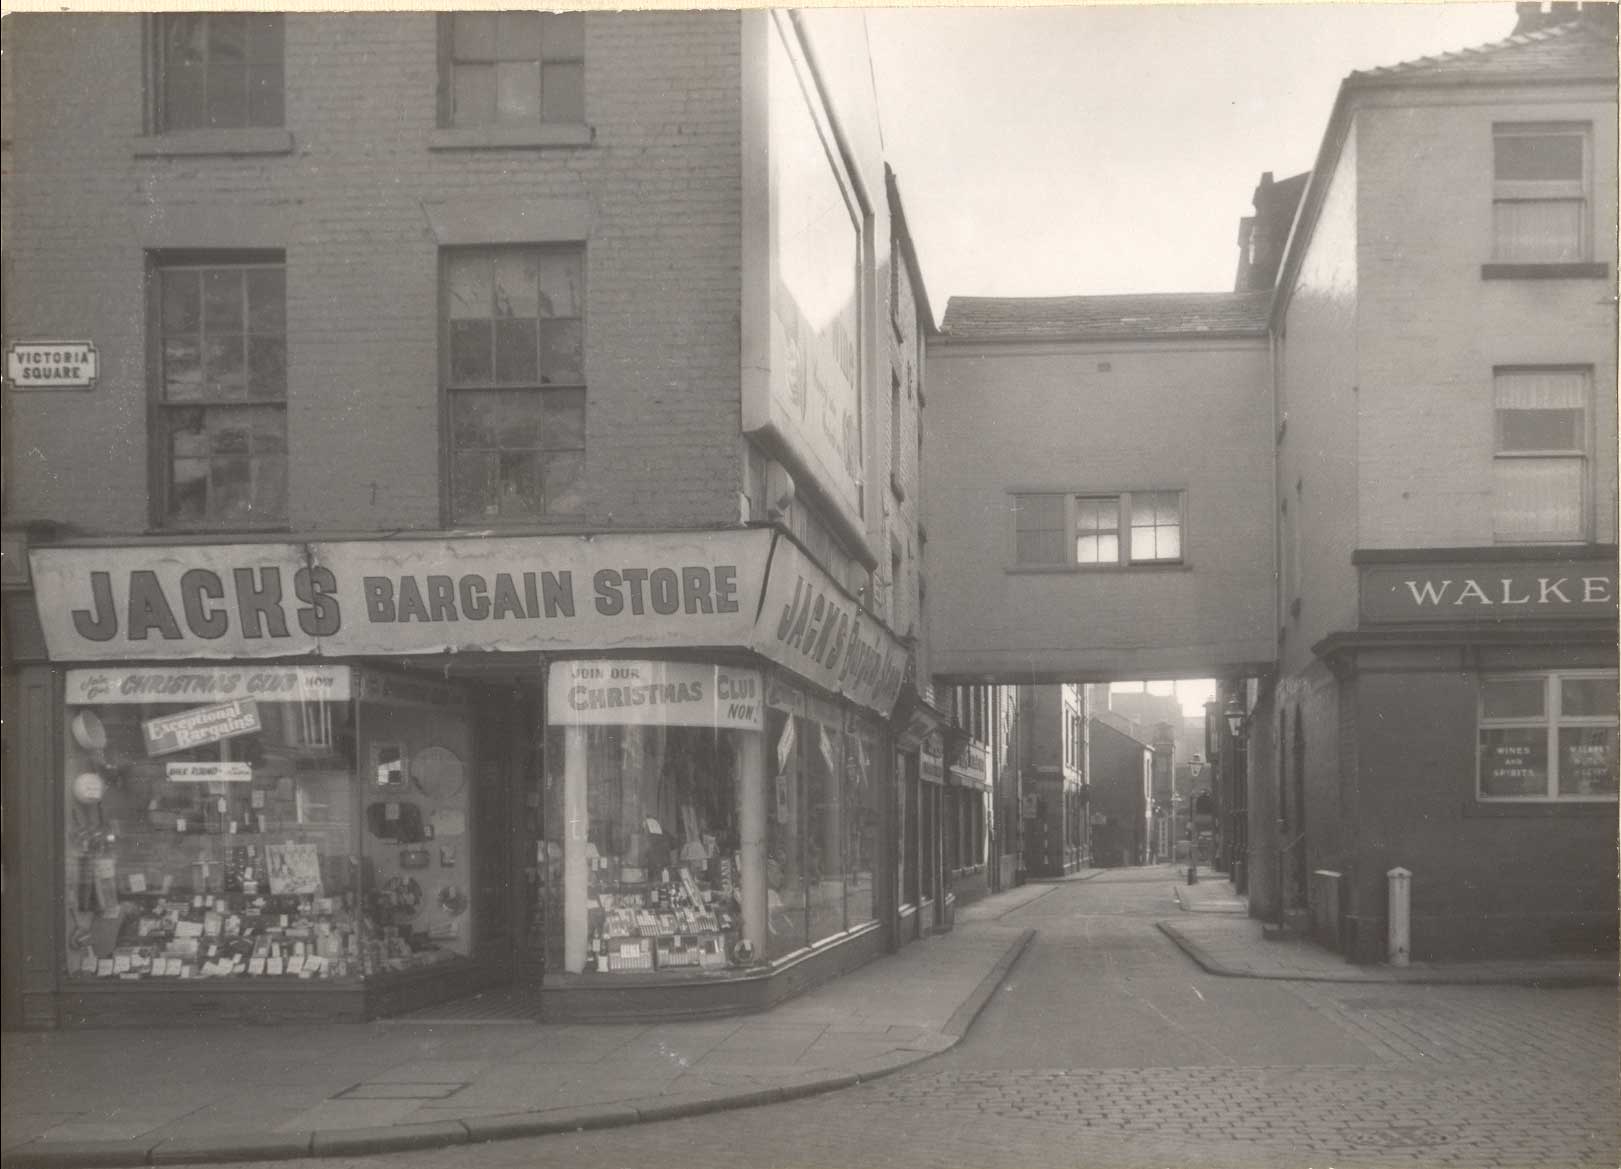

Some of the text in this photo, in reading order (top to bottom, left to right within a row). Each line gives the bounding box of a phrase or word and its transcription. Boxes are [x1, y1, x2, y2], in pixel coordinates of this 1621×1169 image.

[16, 351, 89, 364] VICTORIA
[22, 366, 81, 379] SQUARE
[363, 570, 576, 624] BARGAIN
[593, 565, 740, 616] STORE
[1404, 576, 1611, 606] WALKE
[570, 666, 640, 680] JOIN OUR
[120, 674, 241, 696] CHRISTMAS
[567, 680, 703, 711] CHRISTMAS
[147, 700, 241, 741] Exceptional
[175, 712, 256, 747] Bargains
[1496, 746, 1531, 754] WINES
[1493, 769, 1535, 777] SPIRITS
